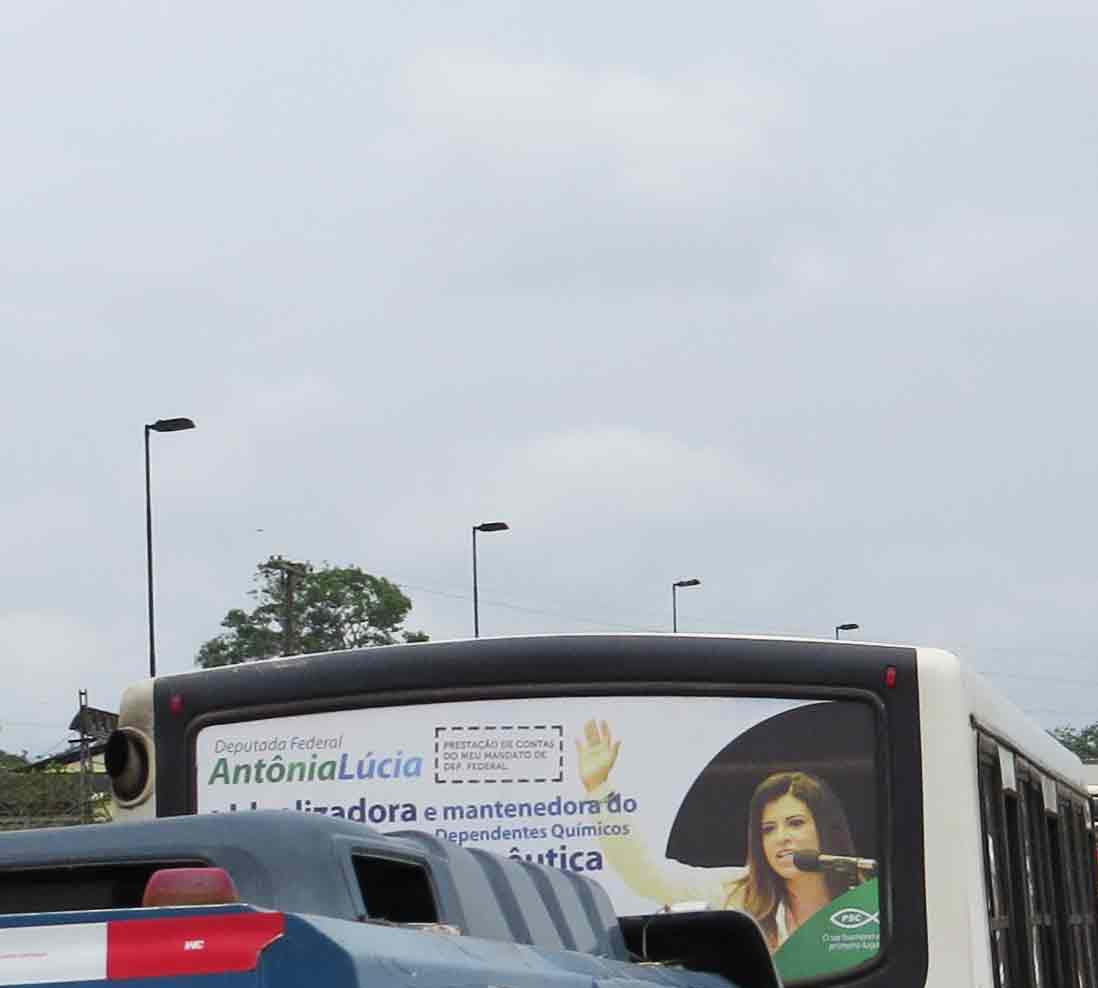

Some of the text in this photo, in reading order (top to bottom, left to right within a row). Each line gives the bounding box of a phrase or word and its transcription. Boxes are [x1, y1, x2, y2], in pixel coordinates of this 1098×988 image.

[214, 734, 344, 755] Deputada Federal
[443, 739, 498, 750] PRESTAÇÃO
[516, 738, 554, 749] CONTAS
[461, 751, 481, 760] MEU
[484, 750, 532, 760] MANDATO
[424, 806, 438, 821] e
[442, 796, 601, 820] mantenedora
[606, 791, 638, 813] do
[436, 822, 631, 846] Dependentes Químicos
